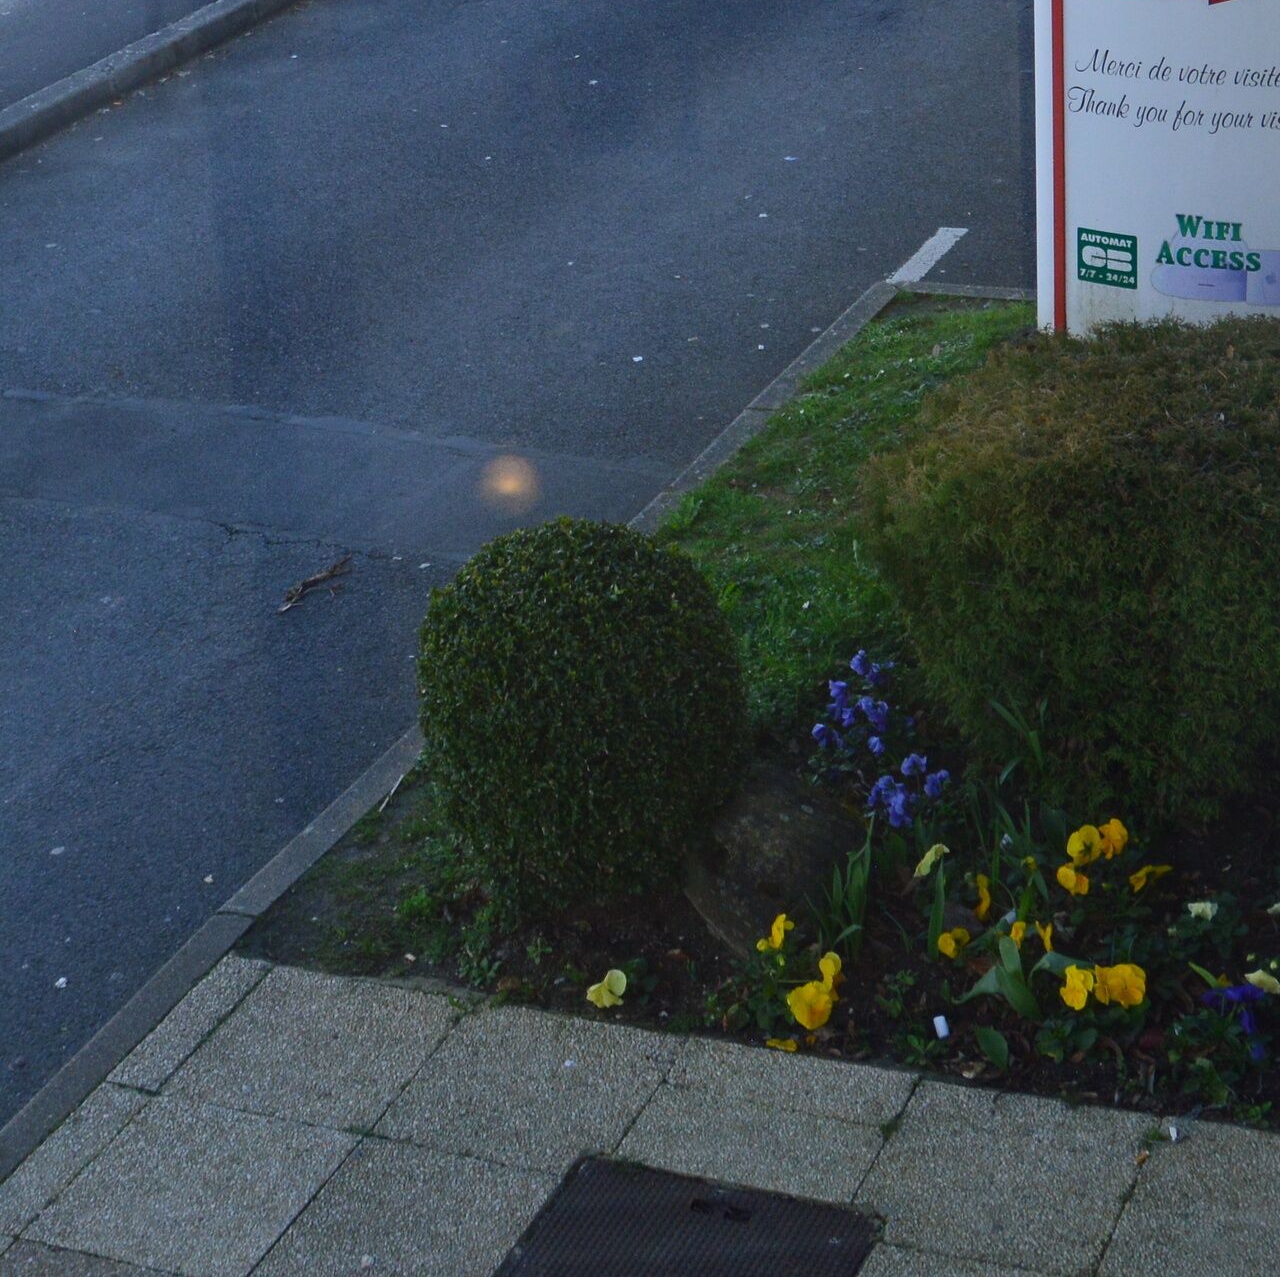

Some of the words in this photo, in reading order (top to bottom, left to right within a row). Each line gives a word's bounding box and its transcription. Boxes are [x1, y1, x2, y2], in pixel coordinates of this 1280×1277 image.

[1075, 48, 1142, 79] Merci
[1148, 56, 1173, 82] de
[1179, 63, 1227, 86] votre
[1067, 85, 1131, 119] Thank
[1134, 105, 1168, 128] you
[1172, 99, 1205, 132] for
[1206, 111, 1254, 135] your
[1080, 232, 1133, 249] AUTOMAT
[1155, 240, 1263, 273] ACCESS
[1079, 268, 1097, 279] 7/7
[1105, 272, 1136, 284] 24/24
